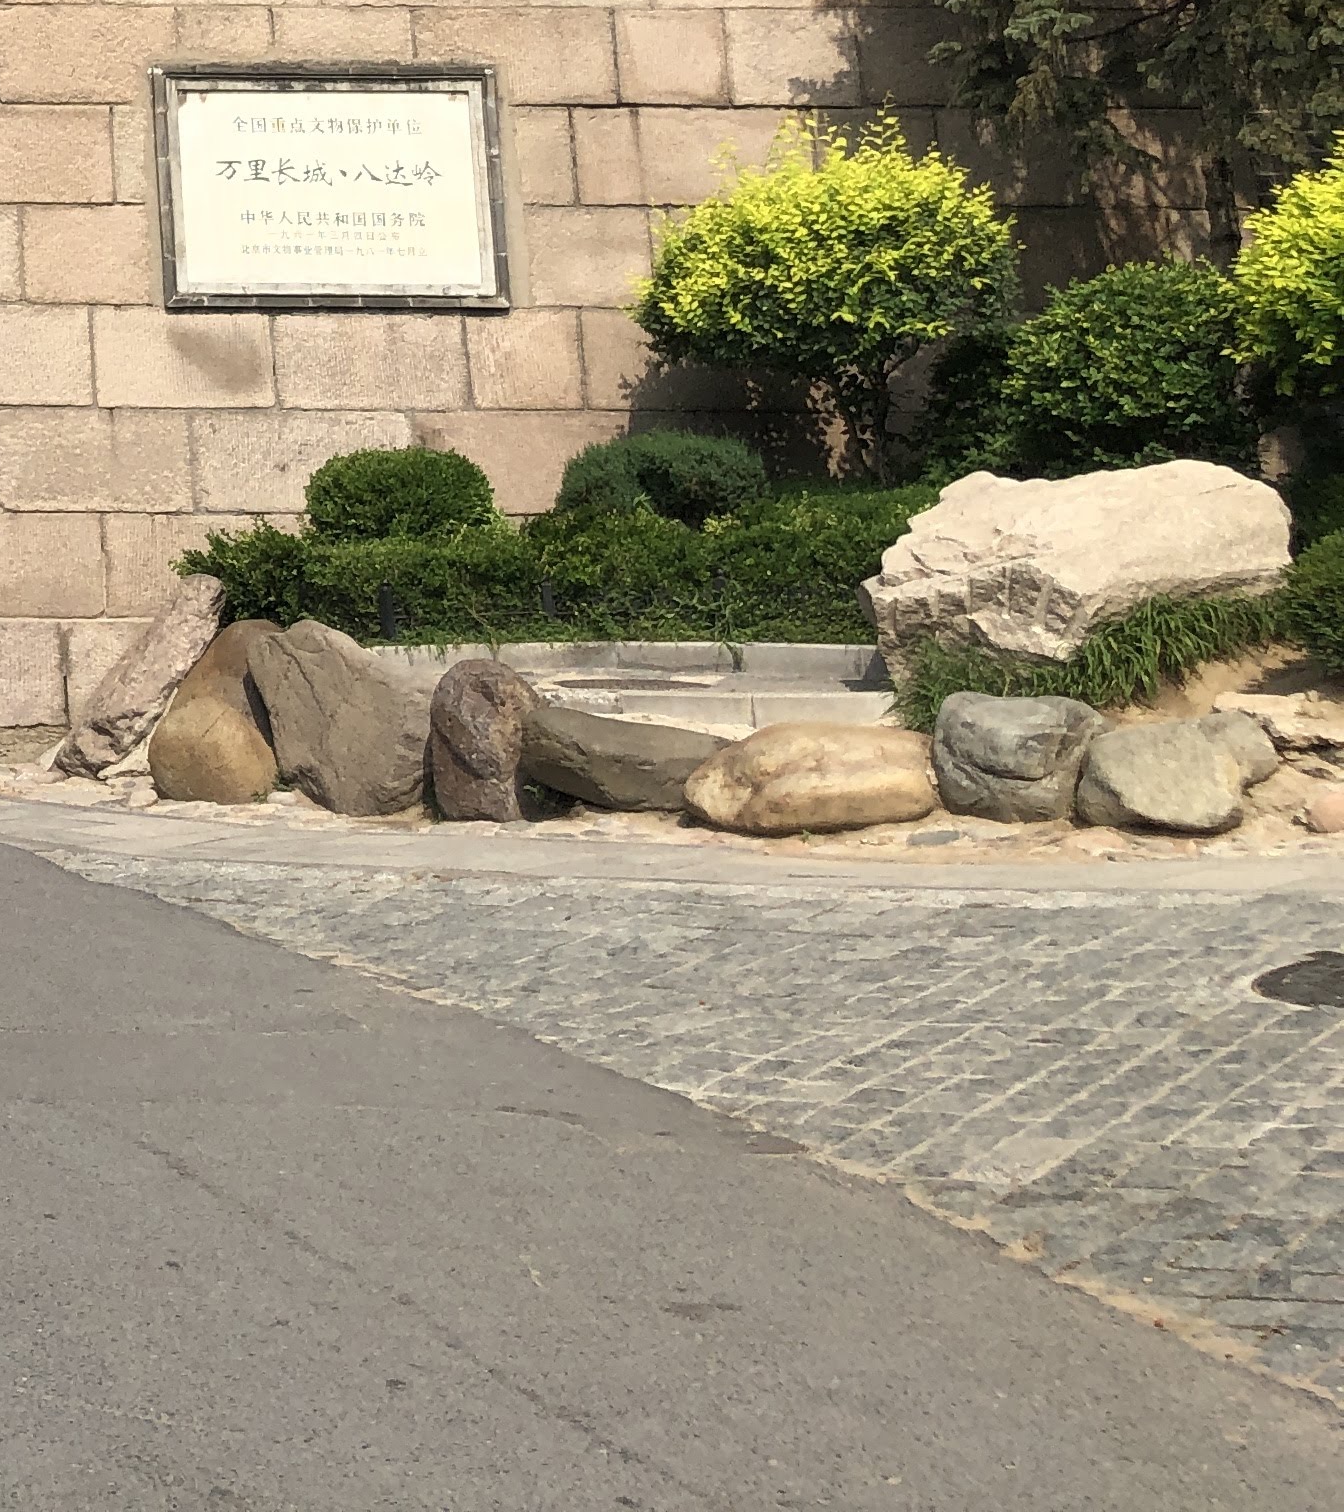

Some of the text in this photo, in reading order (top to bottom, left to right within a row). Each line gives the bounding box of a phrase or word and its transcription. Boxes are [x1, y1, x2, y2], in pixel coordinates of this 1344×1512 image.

[232, 116, 422, 135] 全国重点文物保护单位
[240, 210, 426, 227] 中华人民共和国国务院
